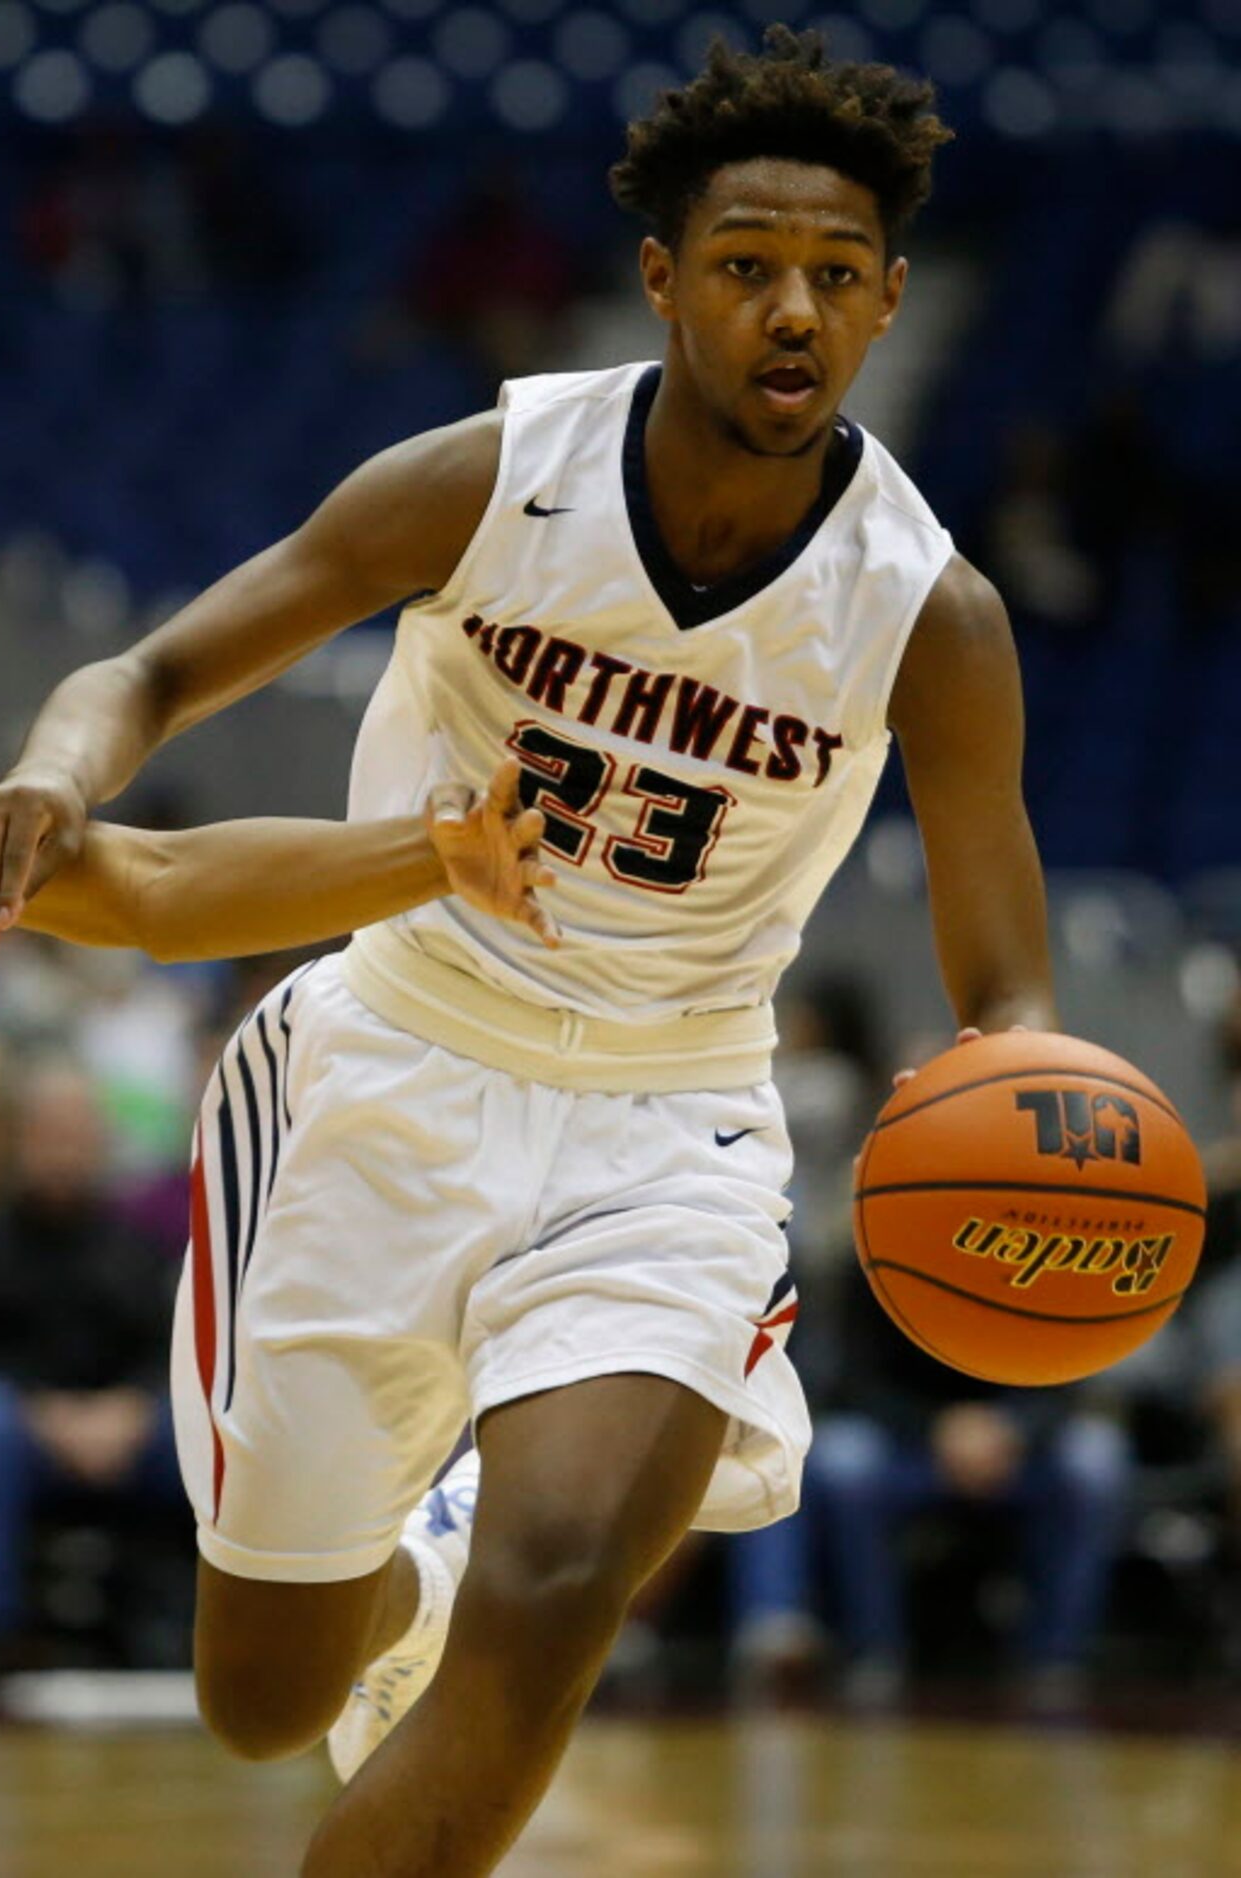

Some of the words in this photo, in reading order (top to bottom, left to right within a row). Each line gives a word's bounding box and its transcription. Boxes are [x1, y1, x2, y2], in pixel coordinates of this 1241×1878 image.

[461, 613, 844, 789] NORTHWEST
[505, 719, 738, 895] 23
[1015, 1089, 1142, 1173] UIL
[952, 1216, 1177, 1297] Baden
